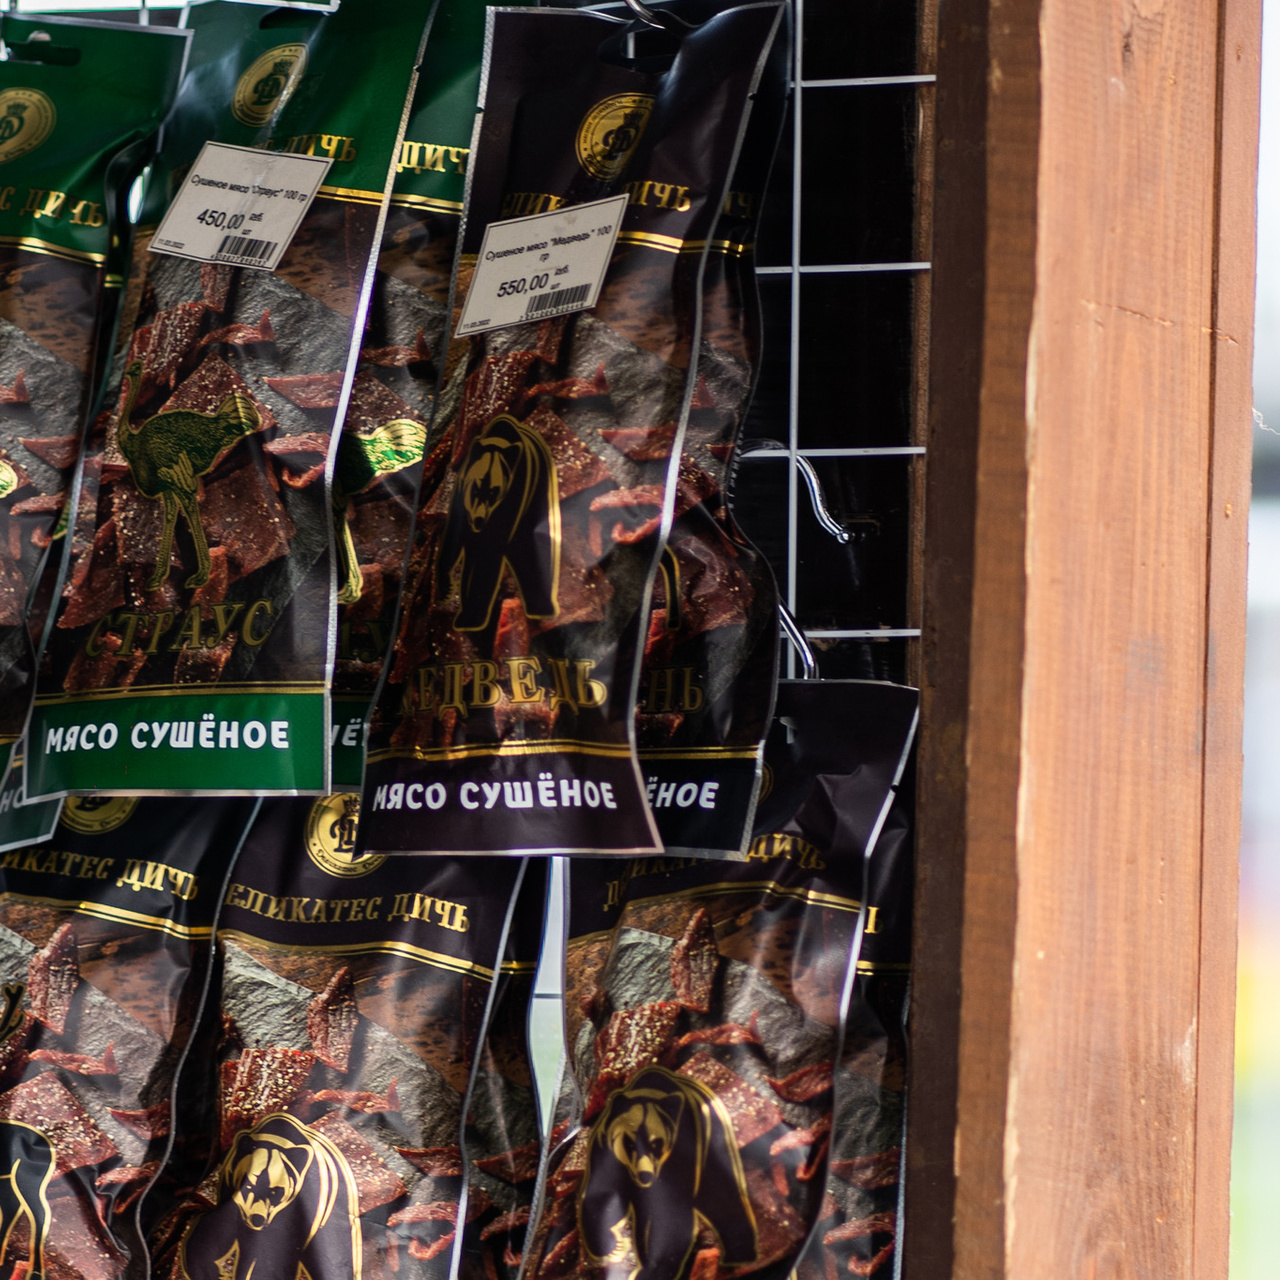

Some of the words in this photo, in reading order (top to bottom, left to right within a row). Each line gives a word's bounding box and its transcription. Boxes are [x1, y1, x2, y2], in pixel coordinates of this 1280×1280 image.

[397, 141, 470, 175] ДИЧ
[19, 188, 106, 228] ДИЧЬ
[196, 208, 245, 231] 450,00
[497, 273, 550, 298] 550,00
[84, 598, 274, 660] СТРАУС
[45, 722, 119, 755] МЯСО
[131, 713, 290, 749] СУШЁНОЕ
[372, 779, 448, 812] МЯСО
[460, 771, 618, 810] СУШЁНОЕ
[646, 775, 720, 810] ЁНОЕ
[224, 882, 383, 924] ЕЛИКАТЕС
[387, 892, 471, 933] ДИЧЬ
